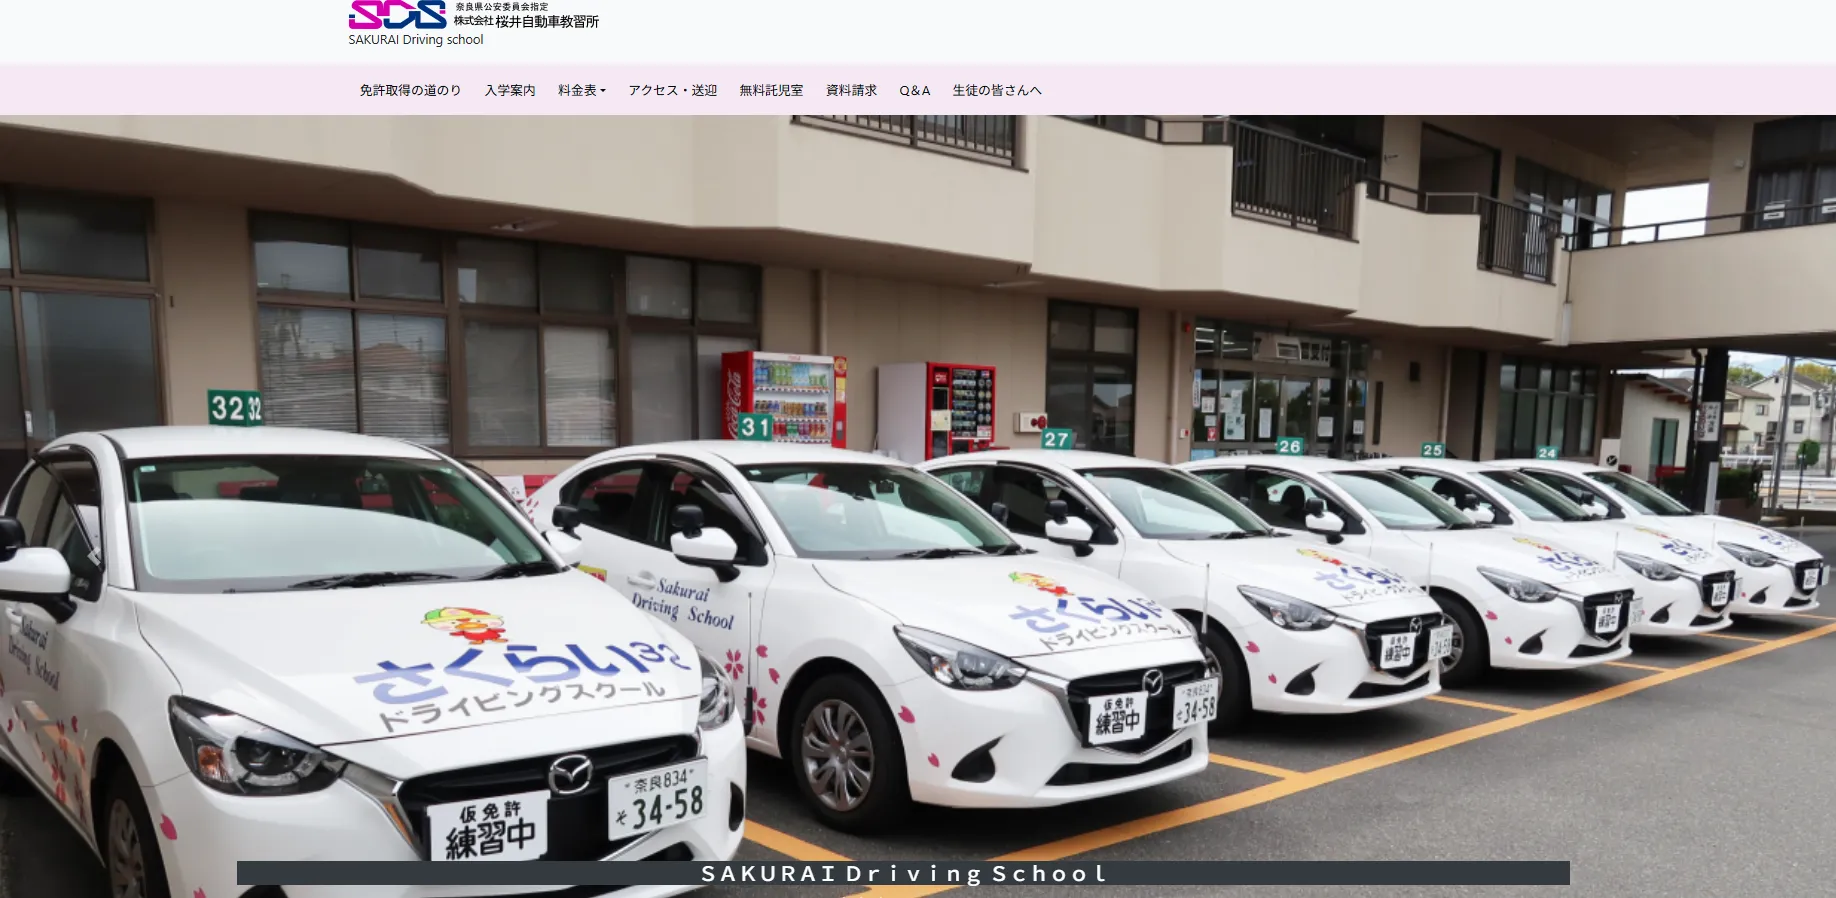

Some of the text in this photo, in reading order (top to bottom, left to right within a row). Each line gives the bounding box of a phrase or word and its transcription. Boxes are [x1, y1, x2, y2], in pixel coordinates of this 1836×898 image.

[212, 395, 245, 420] 32
[248, 396, 262, 420] 32
[741, 417, 769, 437] 31
[1044, 432, 1069, 447] 27
[1279, 440, 1301, 454] 26
[1423, 444, 1442, 457] 25
[1538, 448, 1556, 458] 24
[657, 577, 711, 602] Sakurai
[632, 592, 735, 630] Driving School
[379, 681, 666, 733] ドライビングスクール
[1182, 696, 1216, 724] 34-58
[1095, 708, 1141, 736] 練習中
[459, 800, 521, 824] 仮免許
[632, 785, 704, 829] 34-58
[446, 818, 536, 861] 練習中
